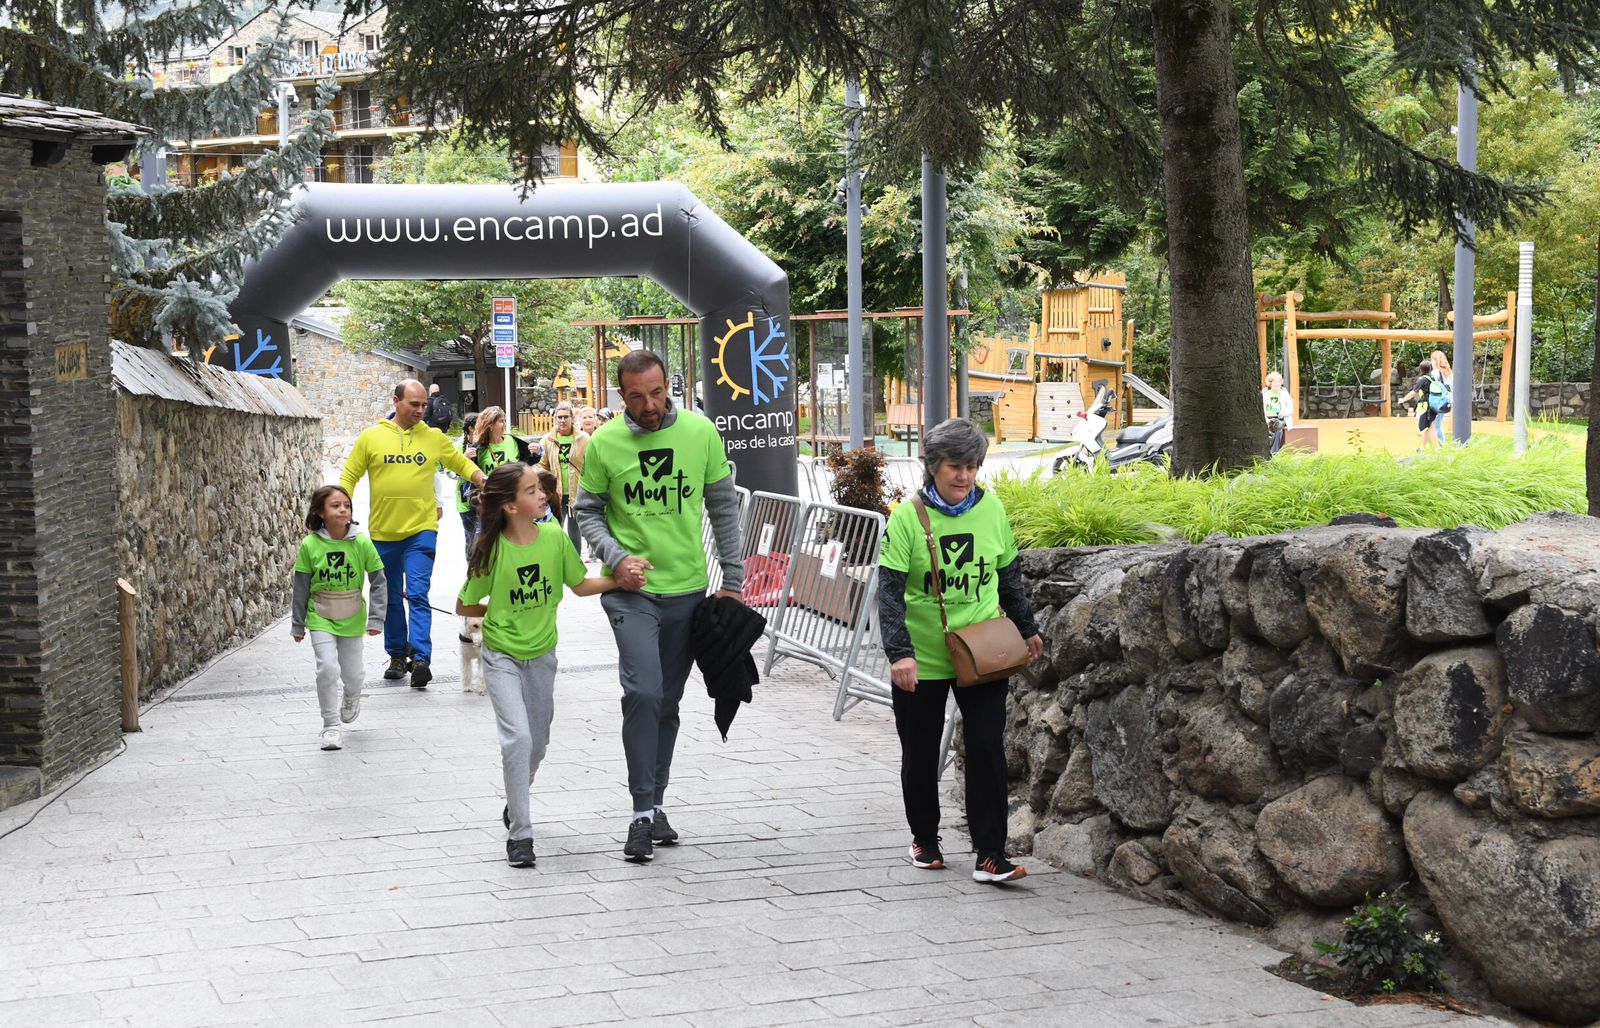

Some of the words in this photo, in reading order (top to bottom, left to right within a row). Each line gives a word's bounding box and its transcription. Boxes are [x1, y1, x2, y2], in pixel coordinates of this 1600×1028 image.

[326, 203, 663, 249] www.encamp.ad
[715, 411, 793, 434] encamp
[727, 439, 747, 453] pas
[749, 435, 765, 448] de
[768, 434, 777, 447] la
[778, 435, 795, 446] casa
[624, 469, 695, 514] Mou-te
[319, 563, 357, 586] Mou-te
[510, 576, 552, 605] Mou-te
